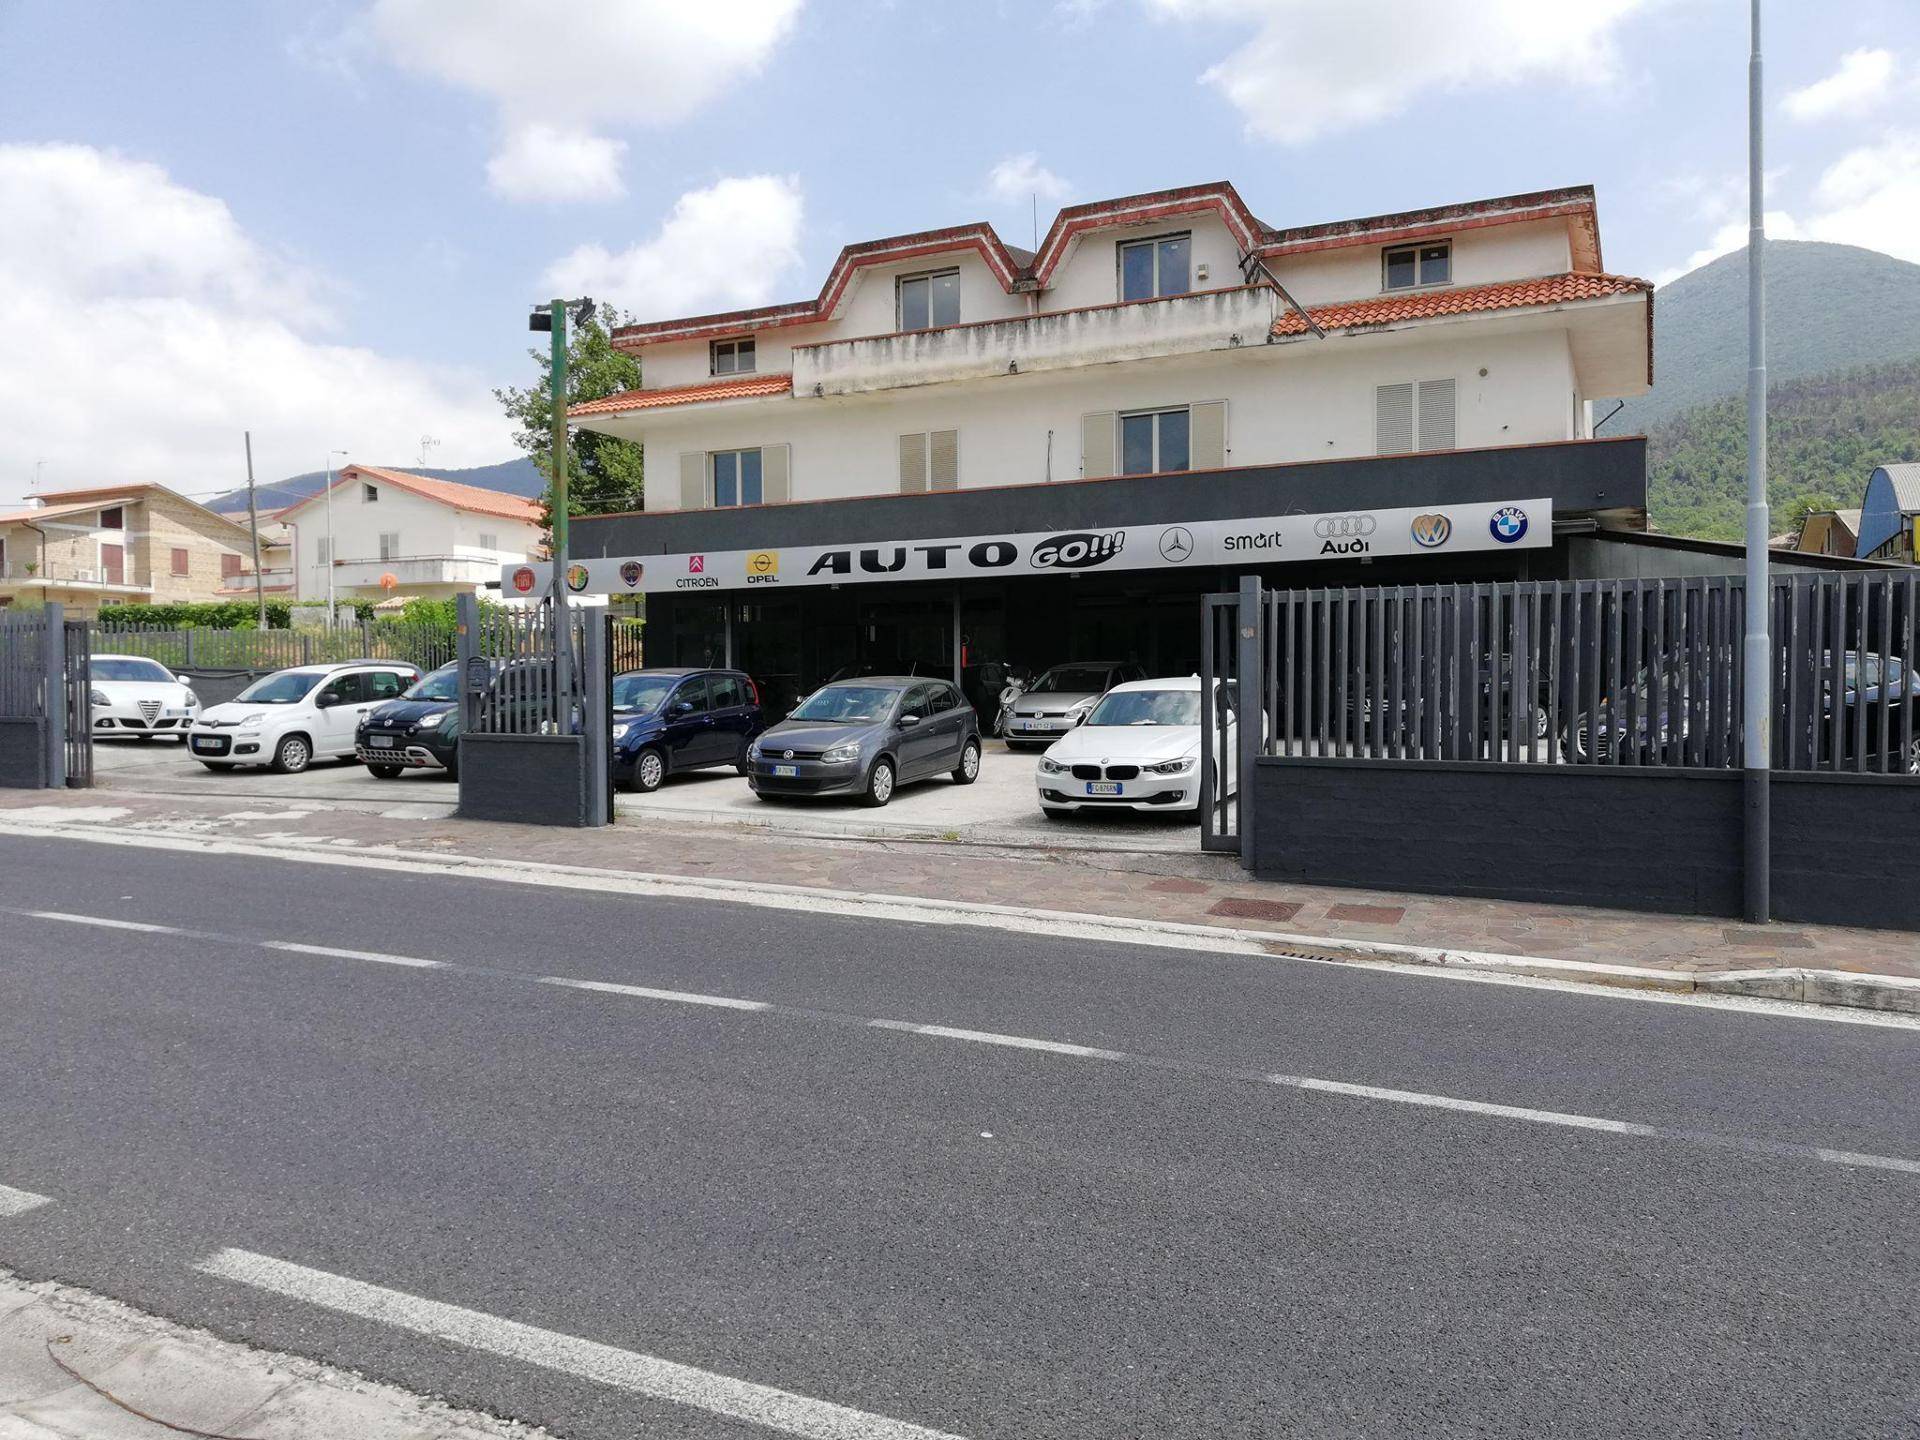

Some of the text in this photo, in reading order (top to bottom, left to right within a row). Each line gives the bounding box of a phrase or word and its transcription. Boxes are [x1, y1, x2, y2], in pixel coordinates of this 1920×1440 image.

[1492, 508, 1526, 522] BMW
[1224, 531, 1282, 550] smart
[1319, 538, 1370, 555] Audi
[806, 531, 1126, 576] AUTO GO!!!
[747, 575, 779, 584] OPEL
